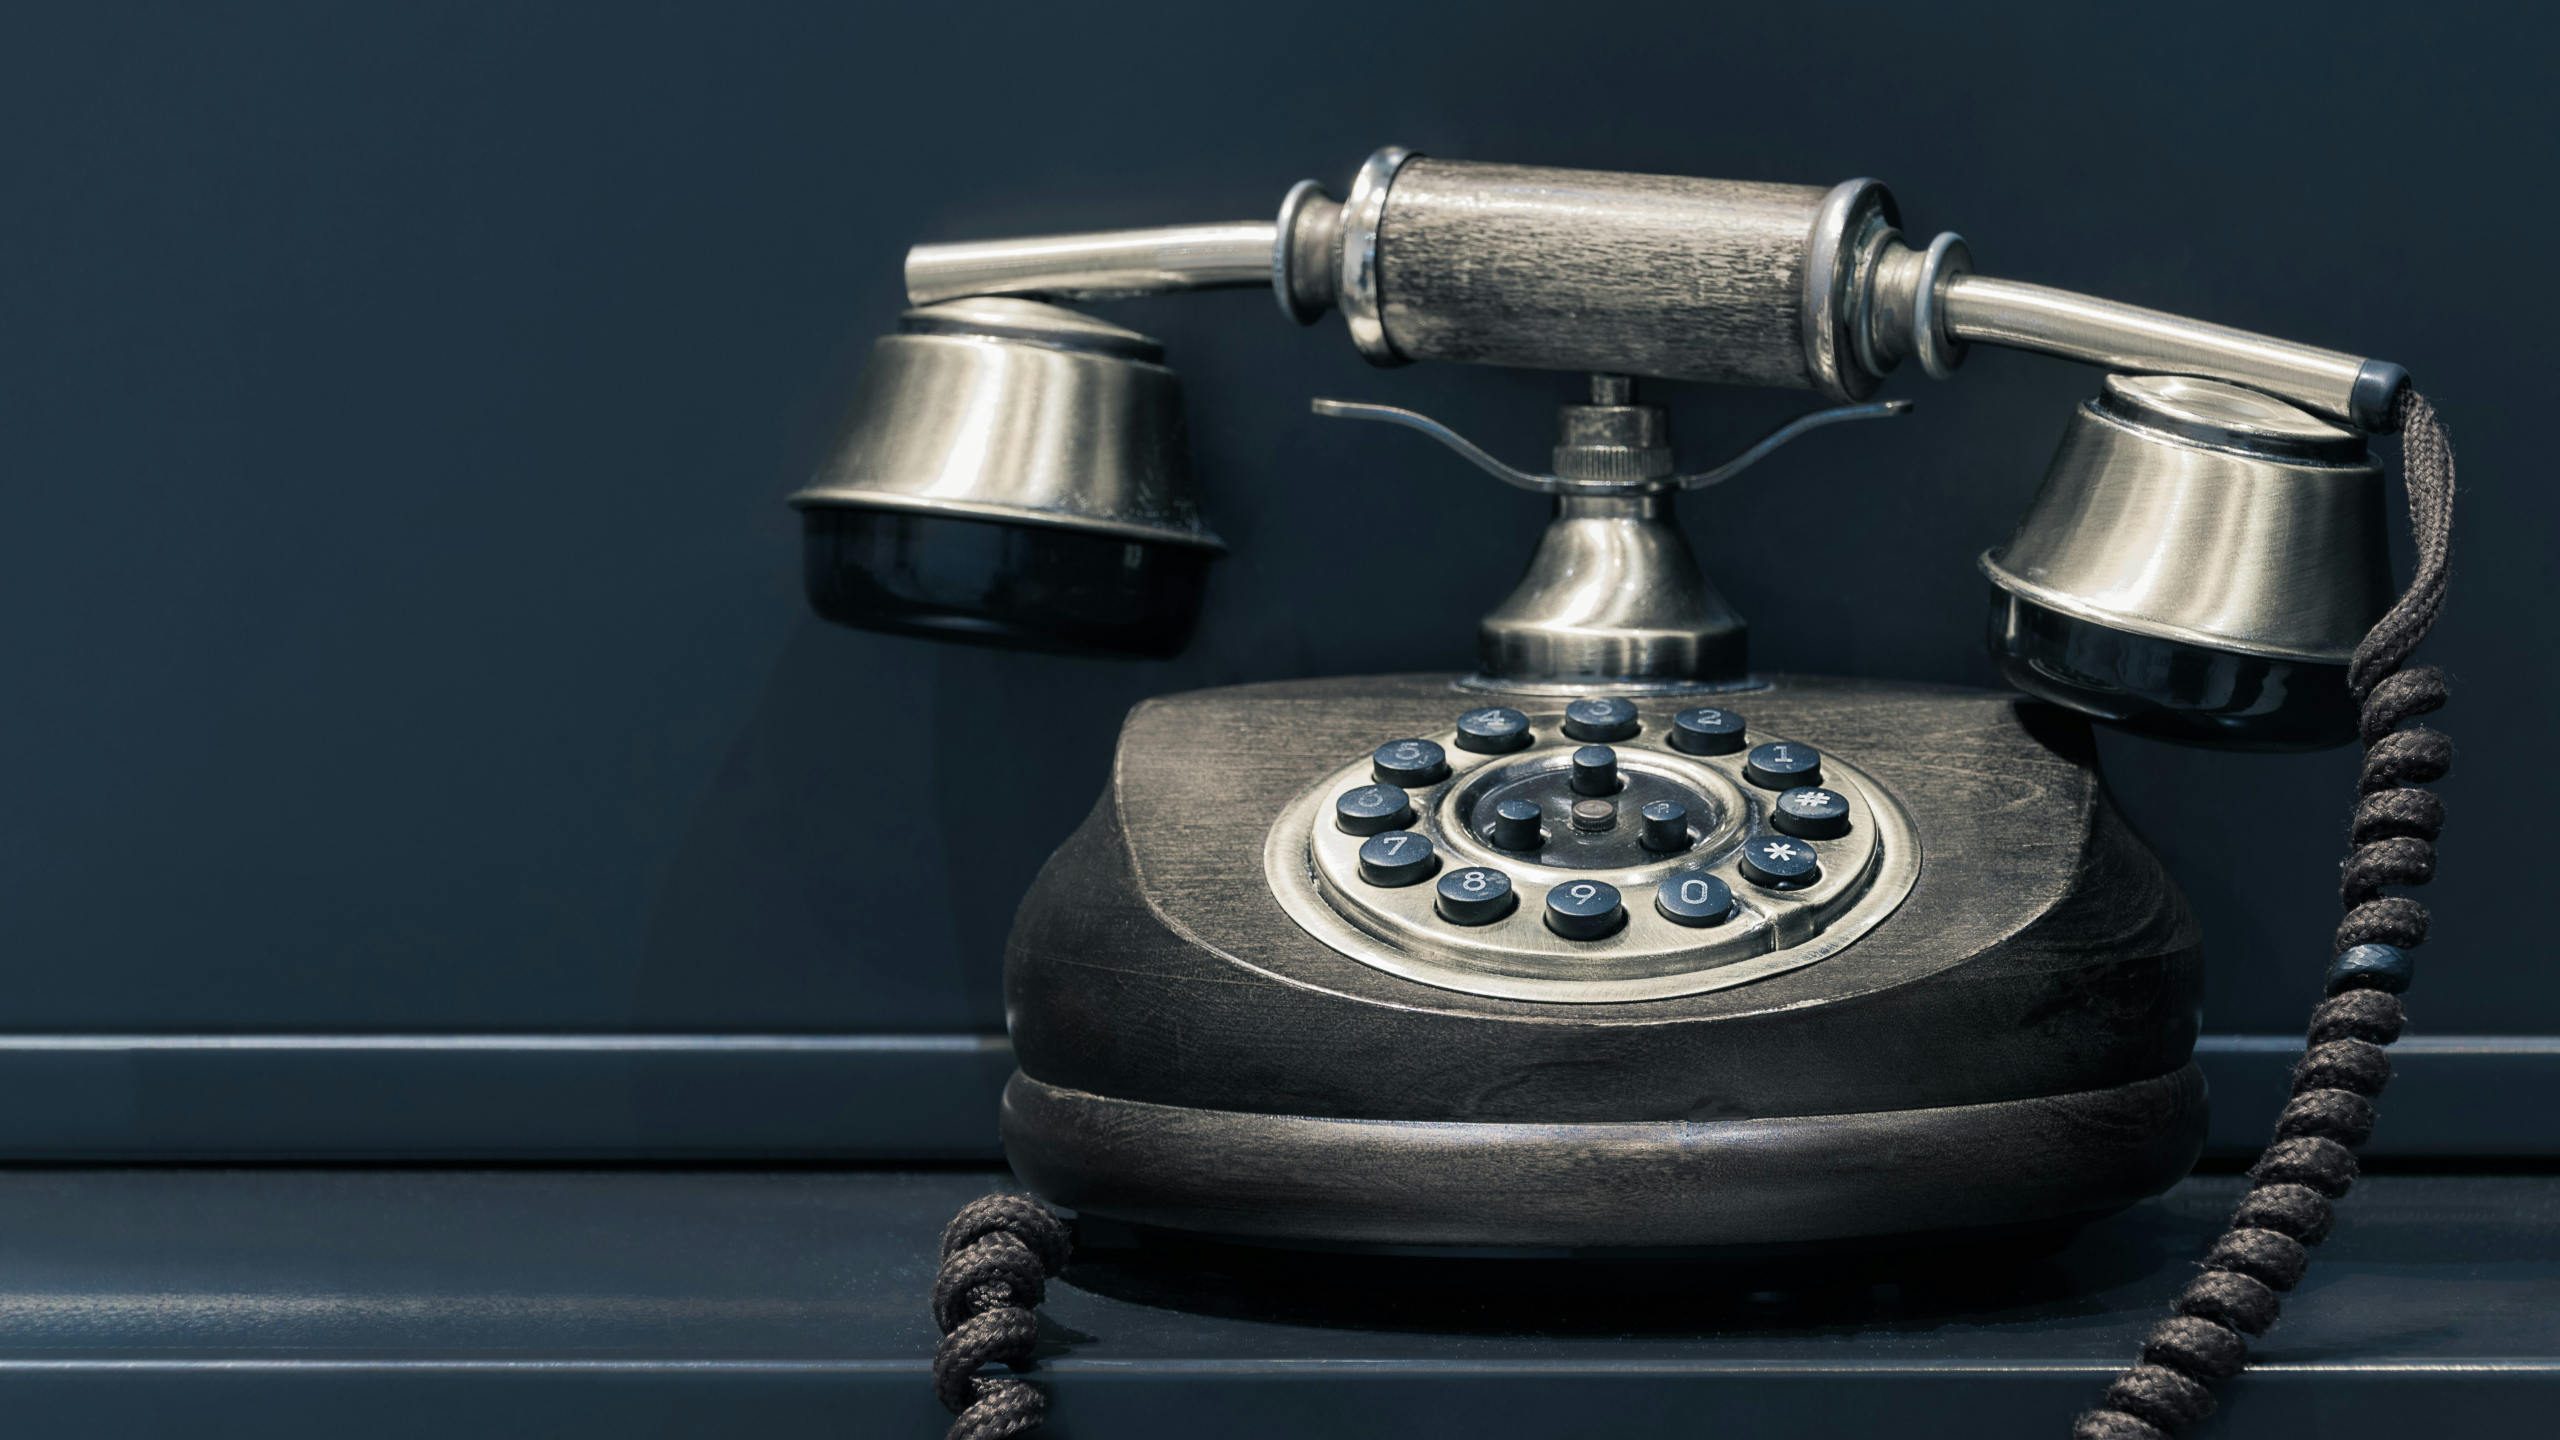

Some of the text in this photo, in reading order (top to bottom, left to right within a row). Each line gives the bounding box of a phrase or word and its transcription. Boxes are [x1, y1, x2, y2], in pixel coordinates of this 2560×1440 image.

[1478, 709, 1505, 726] 4
[1697, 709, 1722, 725] 2
[1395, 742, 1421, 760] 5
[1773, 745, 1793, 763] 1
[1358, 788, 1383, 807] 6
[1795, 791, 1830, 807] #
[1383, 836, 1408, 856] 7
[1463, 871, 1486, 892] 8
[1570, 884, 1596, 905] 9
